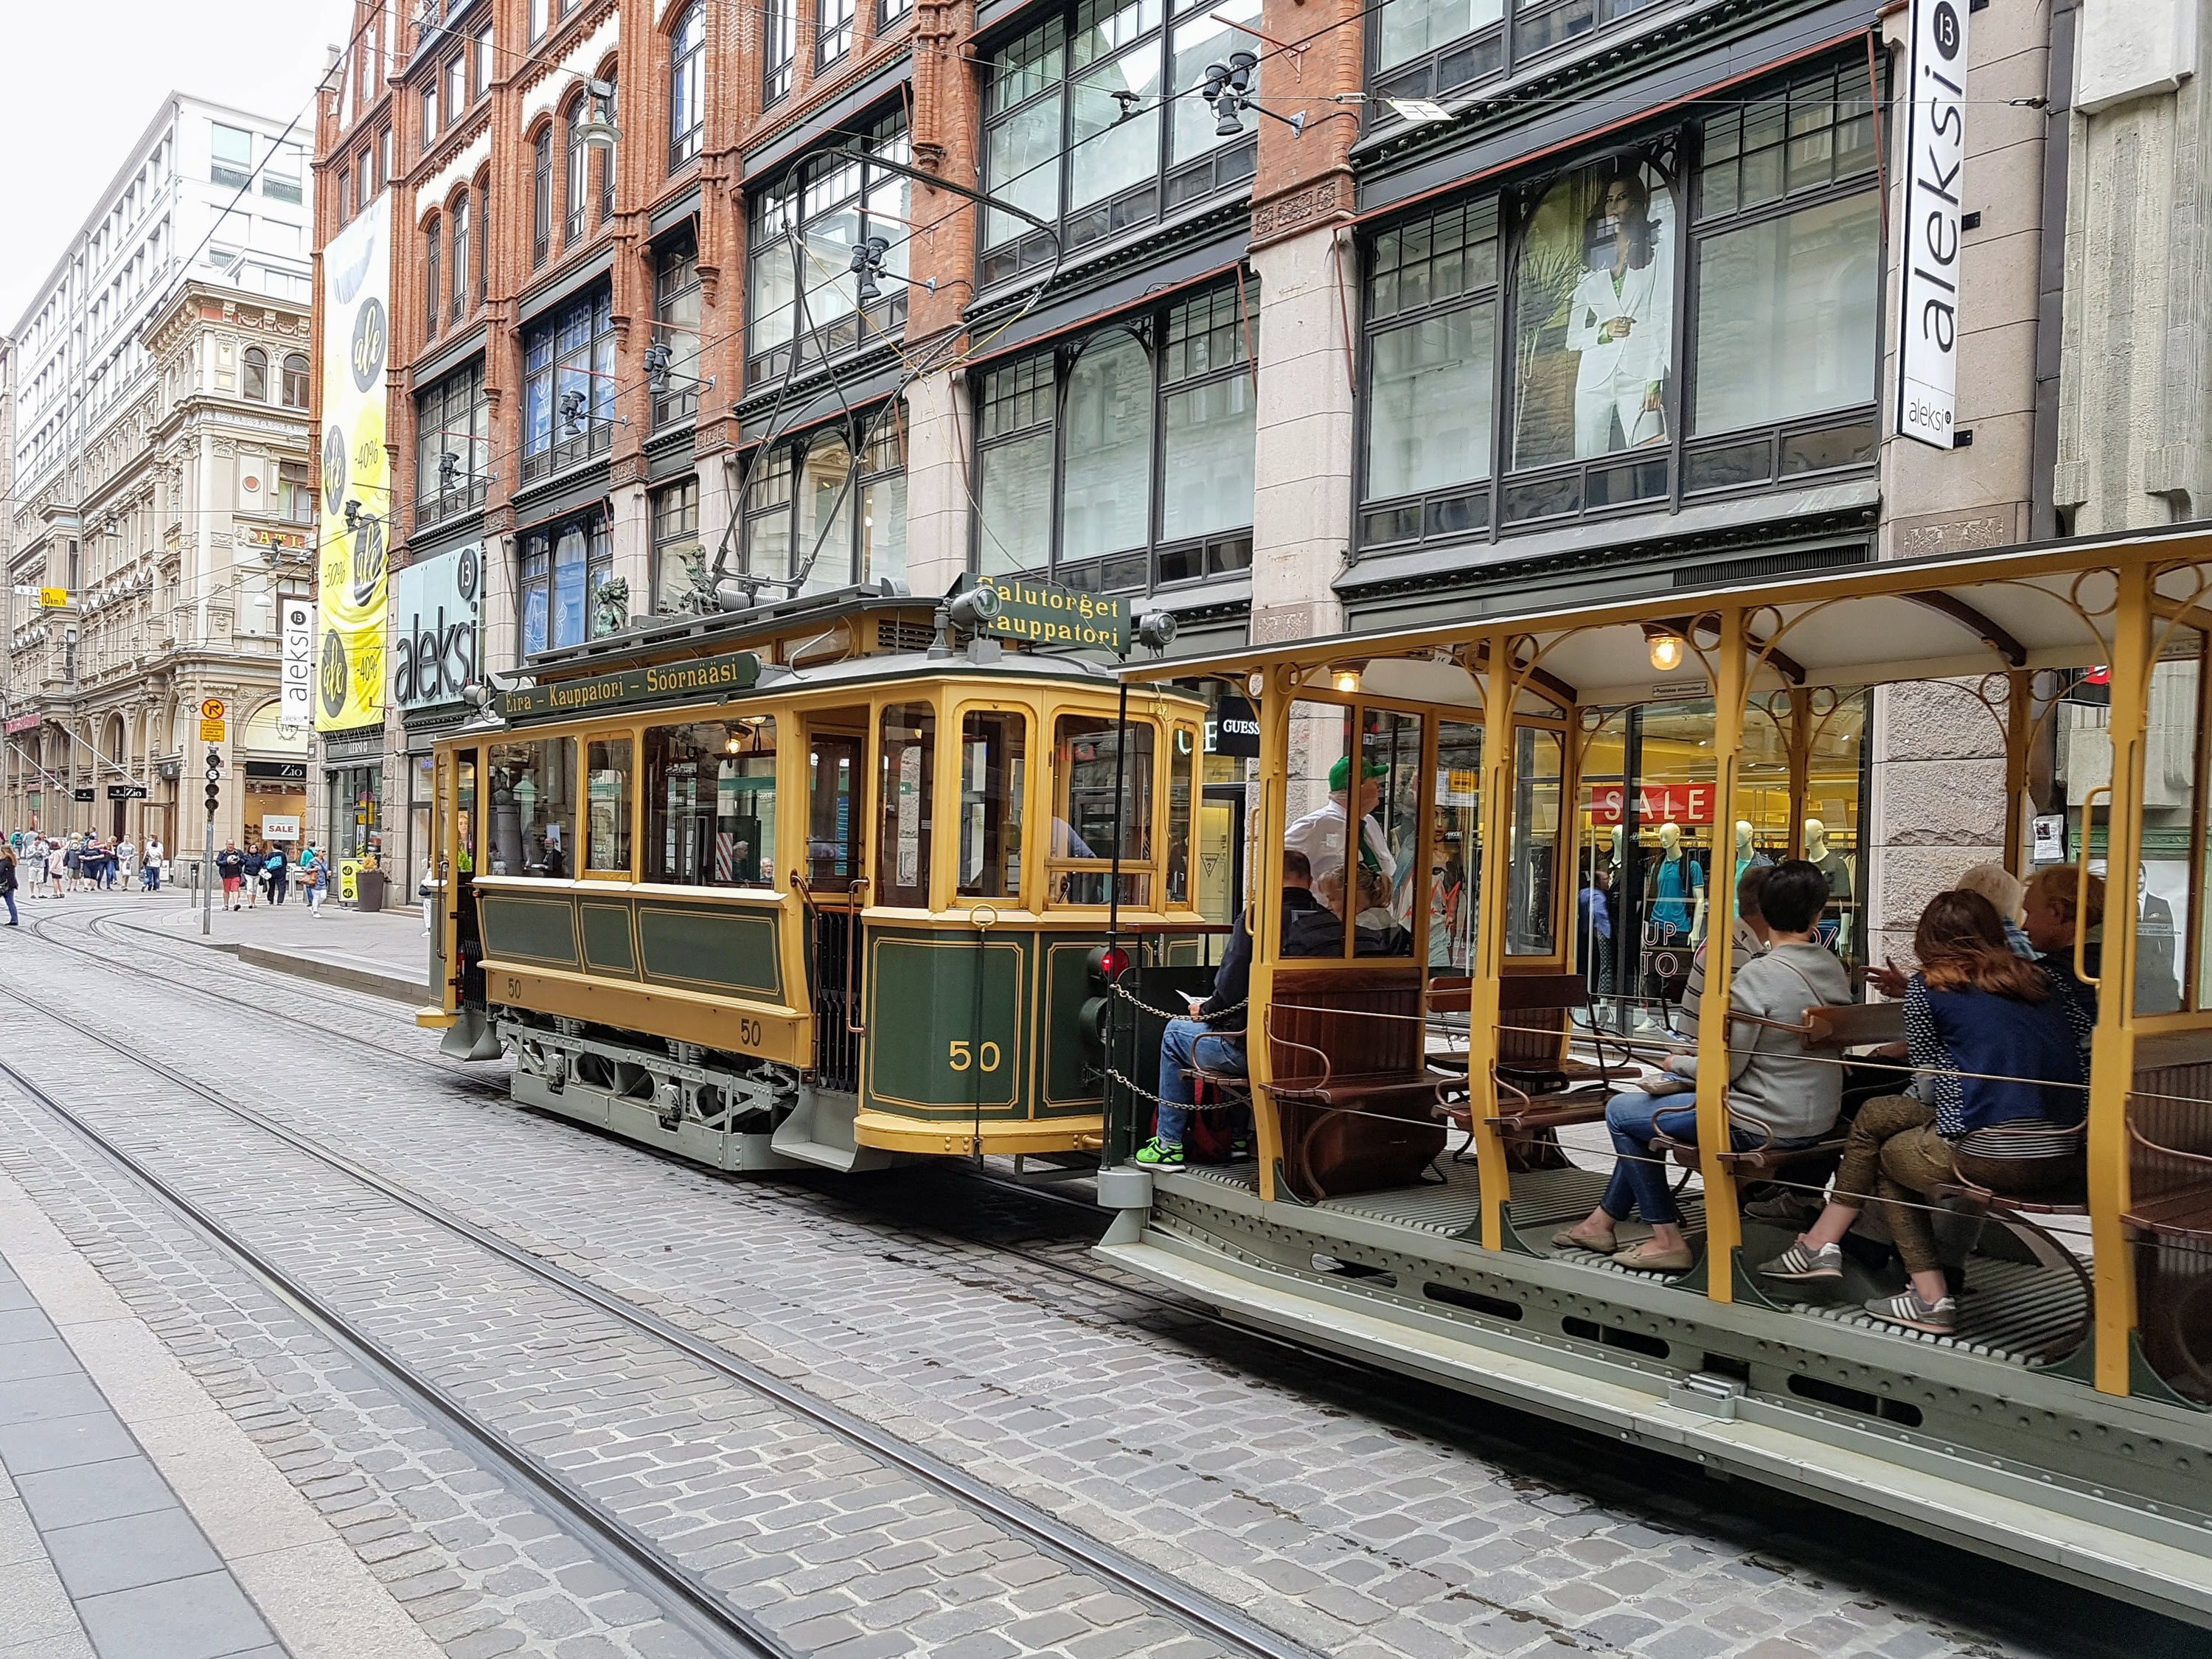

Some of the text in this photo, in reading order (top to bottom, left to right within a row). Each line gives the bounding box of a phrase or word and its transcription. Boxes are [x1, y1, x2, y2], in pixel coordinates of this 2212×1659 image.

[1940, 12, 1953, 46] 13
[1914, 63, 1963, 353] aleksi
[355, 305, 383, 377] ale
[1909, 397, 1944, 434] aleksi
[325, 433, 344, 500] ale
[355, 438, 378, 470] -40%
[356, 522, 380, 588] ale
[461, 560, 471, 588] 13
[293, 613, 303, 623] 13
[988, 615, 1119, 647] auppatori
[283, 628, 309, 702] aleksi
[394, 600, 478, 704] aleksi
[324, 638, 345, 703] ale
[356, 655, 378, 682] -40%
[505, 692, 532, 713] Eira
[549, 675, 625, 709] Kauppatori
[647, 656, 738, 693] Söörnääsi
[1222, 719, 1261, 735] GUESS
[280, 764, 303, 777] Zio
[125, 787, 142, 797] Zio
[1604, 788, 1706, 821] SALE
[268, 825, 294, 833] SALE
[1642, 921, 1677, 946] UP
[1641, 951, 1678, 978] TO
[508, 977, 521, 1000] 50
[741, 1018, 761, 1047] 50
[949, 1040, 1001, 1072] 50
